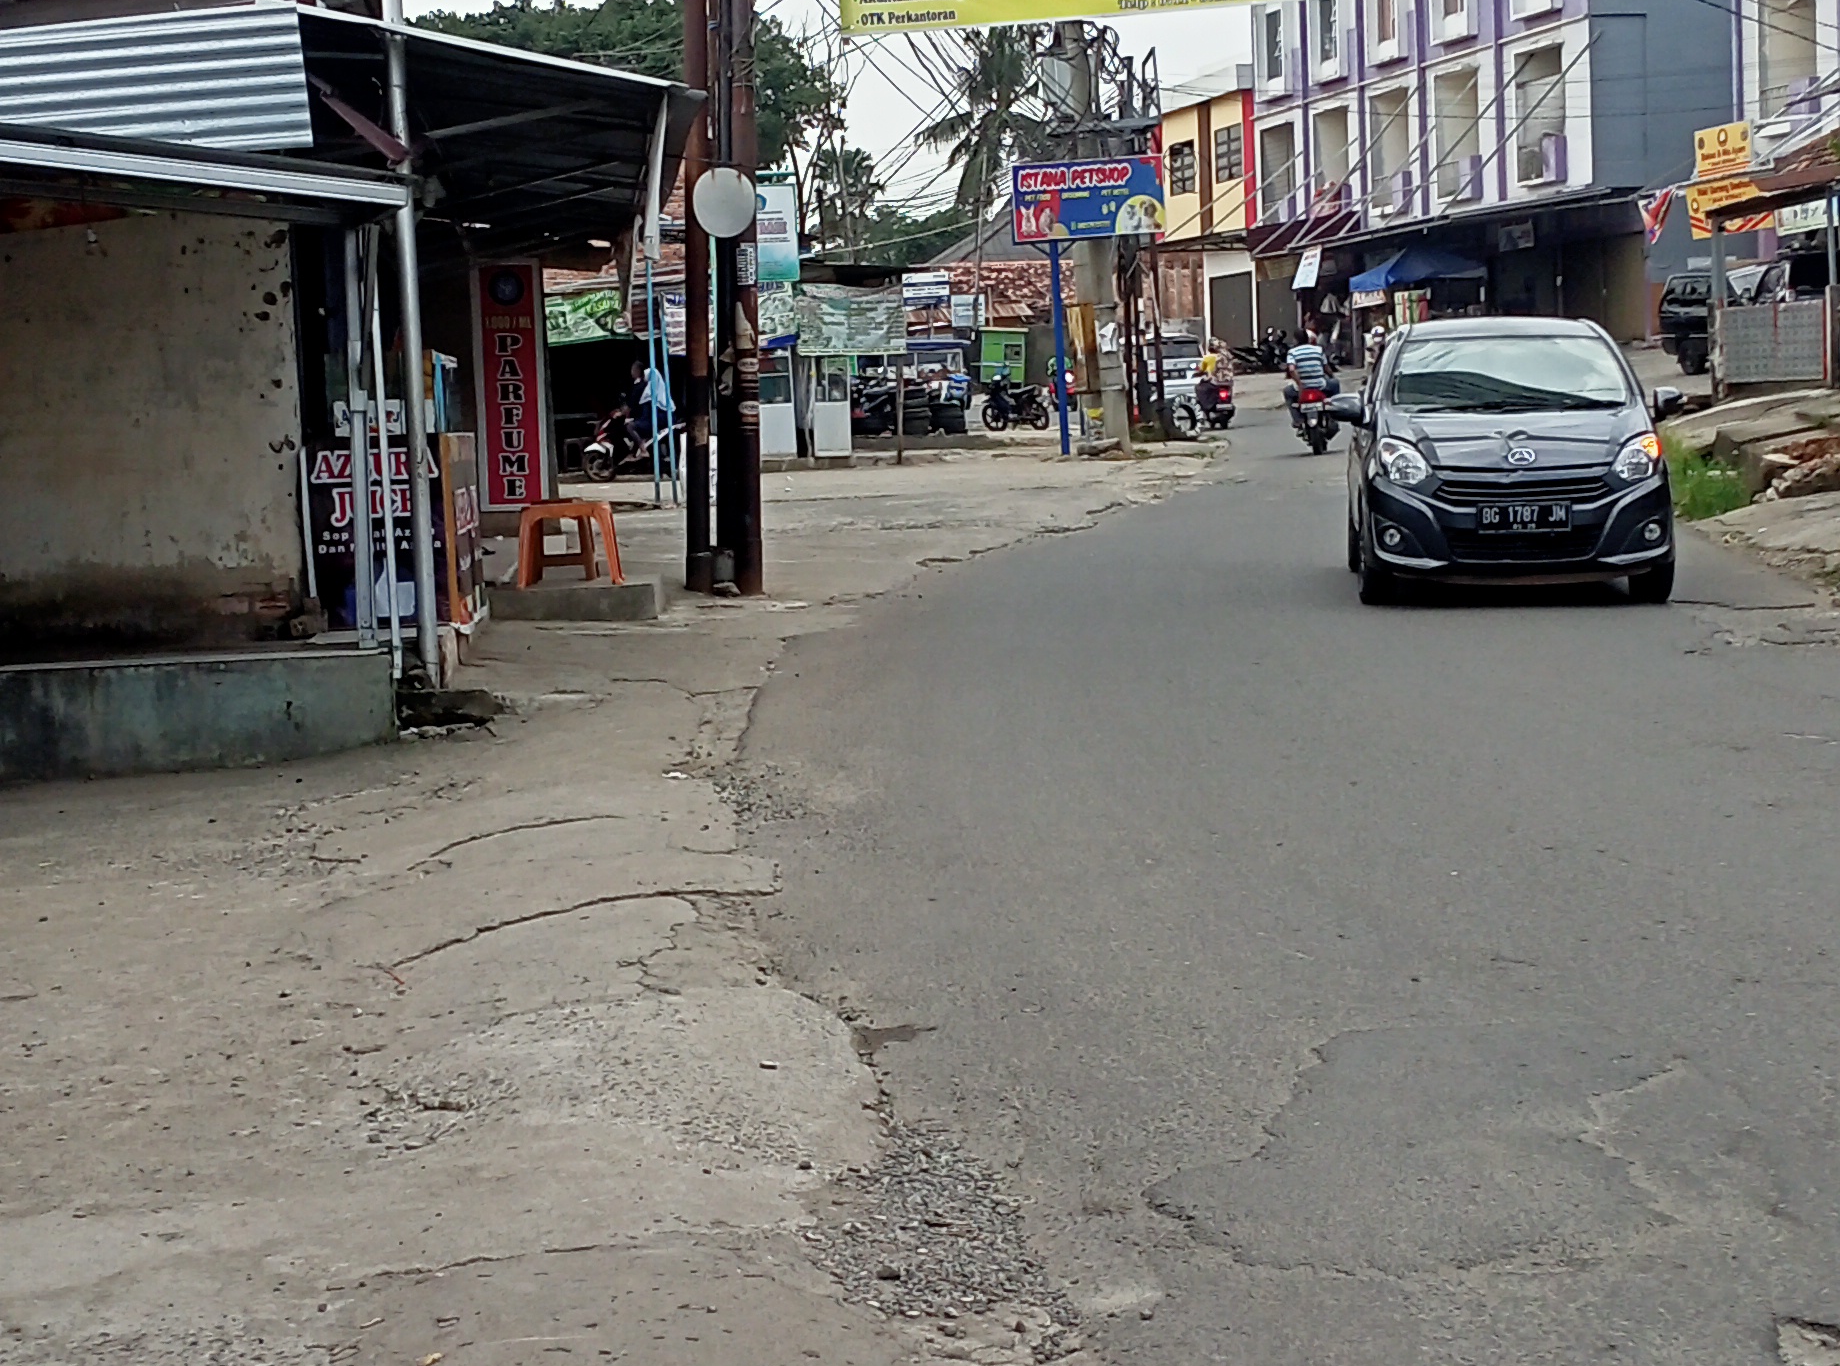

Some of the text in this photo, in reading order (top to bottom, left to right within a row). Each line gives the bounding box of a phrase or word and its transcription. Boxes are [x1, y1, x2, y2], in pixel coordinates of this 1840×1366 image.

[861, 9, 956, 26] OTK Perkantoran
[1018, 164, 1131, 191] ISTANA PETSHOP
[494, 332, 529, 500] PARFUME
[1482, 507, 1500, 524] BG
[1508, 505, 1540, 523] 1787
